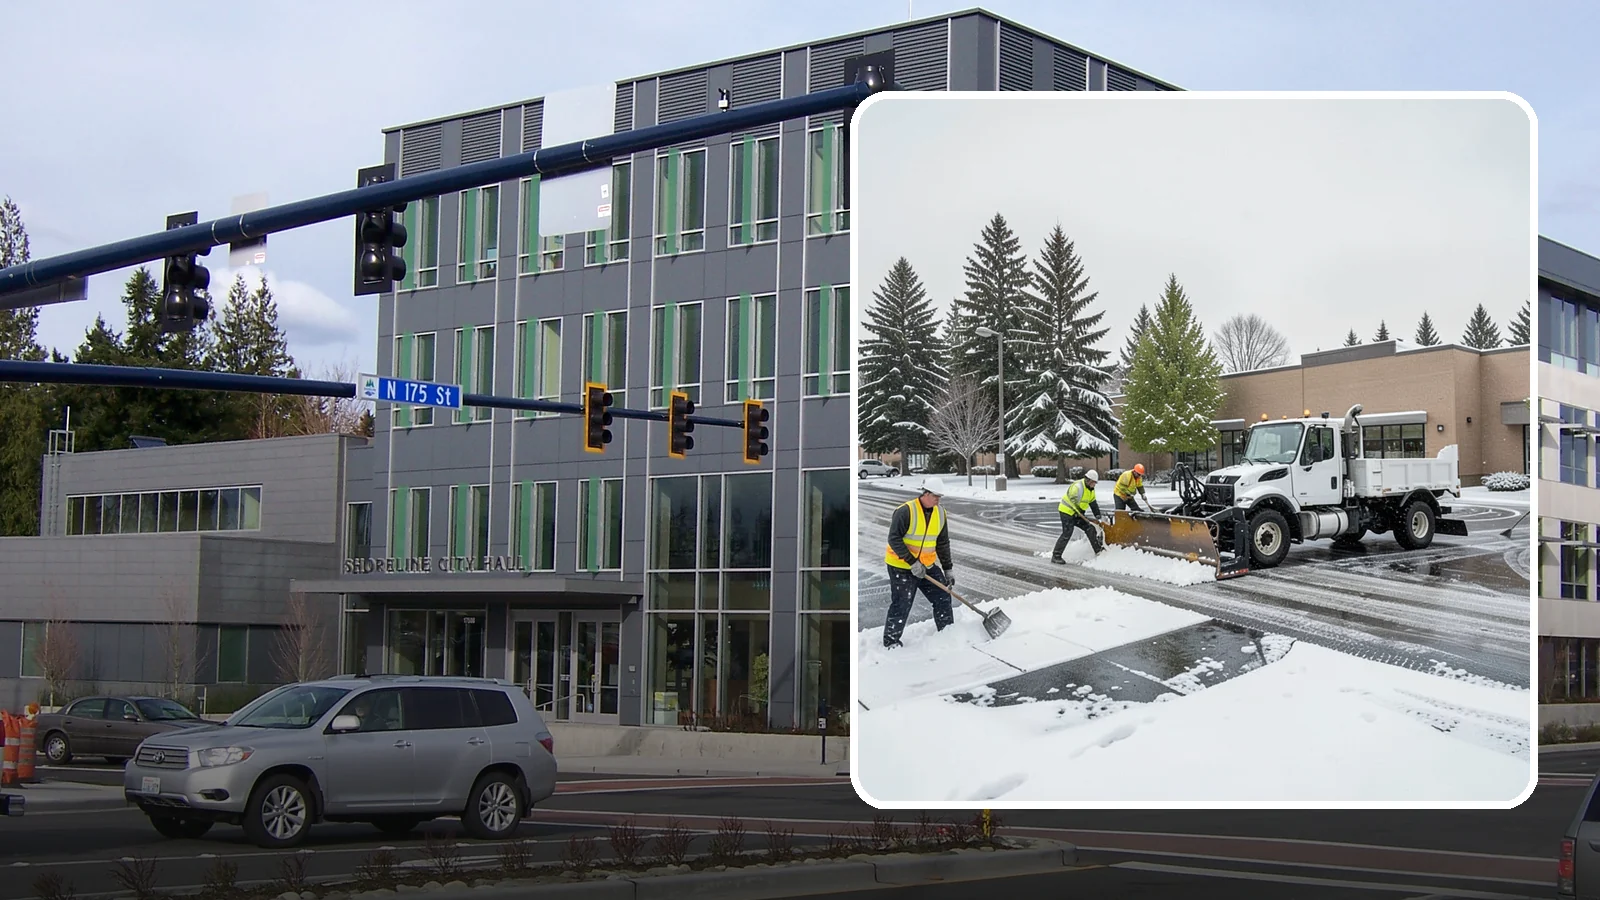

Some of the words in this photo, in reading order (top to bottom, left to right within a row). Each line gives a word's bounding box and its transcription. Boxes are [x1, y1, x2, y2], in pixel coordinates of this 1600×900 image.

[387, 380, 396, 400] N
[405, 382, 427, 403] 175
[436, 386, 451, 406] St
[344, 556, 432, 574] SHORELINE
[438, 555, 476, 573] CITY
[484, 555, 525, 572] HALL
